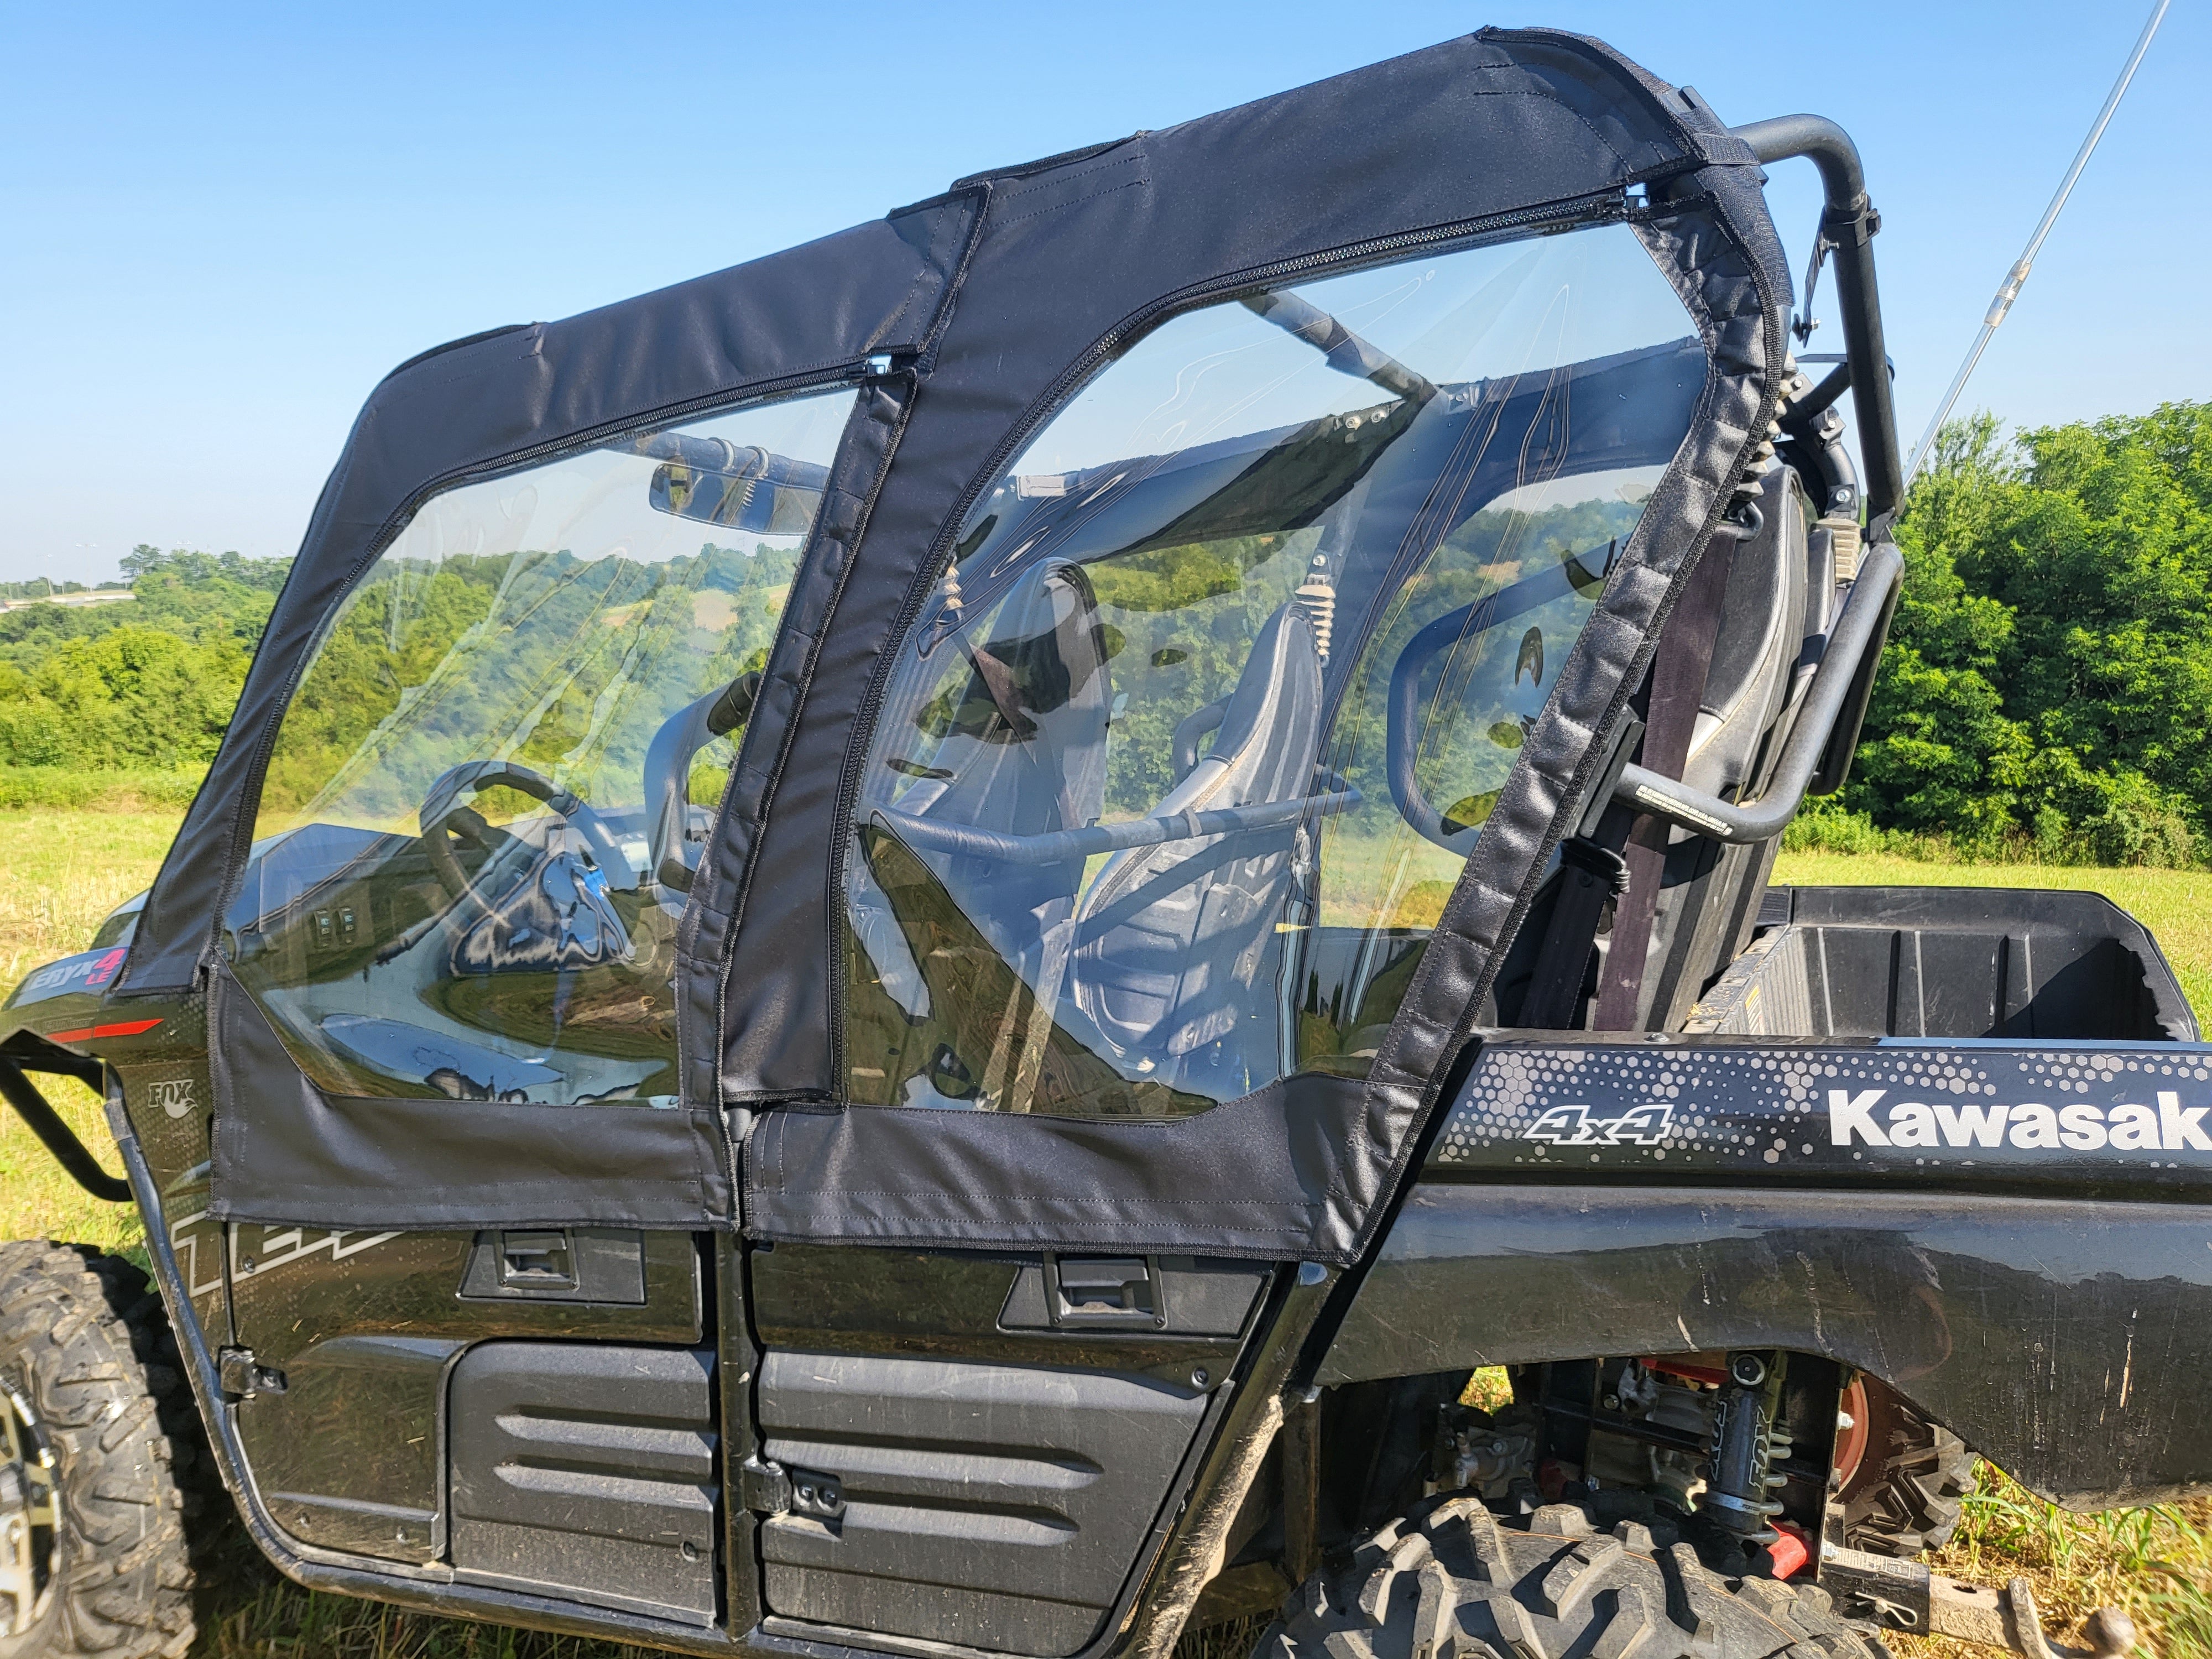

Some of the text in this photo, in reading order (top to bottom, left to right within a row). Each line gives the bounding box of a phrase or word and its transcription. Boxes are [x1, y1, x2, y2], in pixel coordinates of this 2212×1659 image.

[85, 969, 113, 985] LE
[148, 1079, 195, 1108] FOX
[1522, 1104, 1674, 1145] 4x4
[1749, 1405, 1771, 1493] FOX
